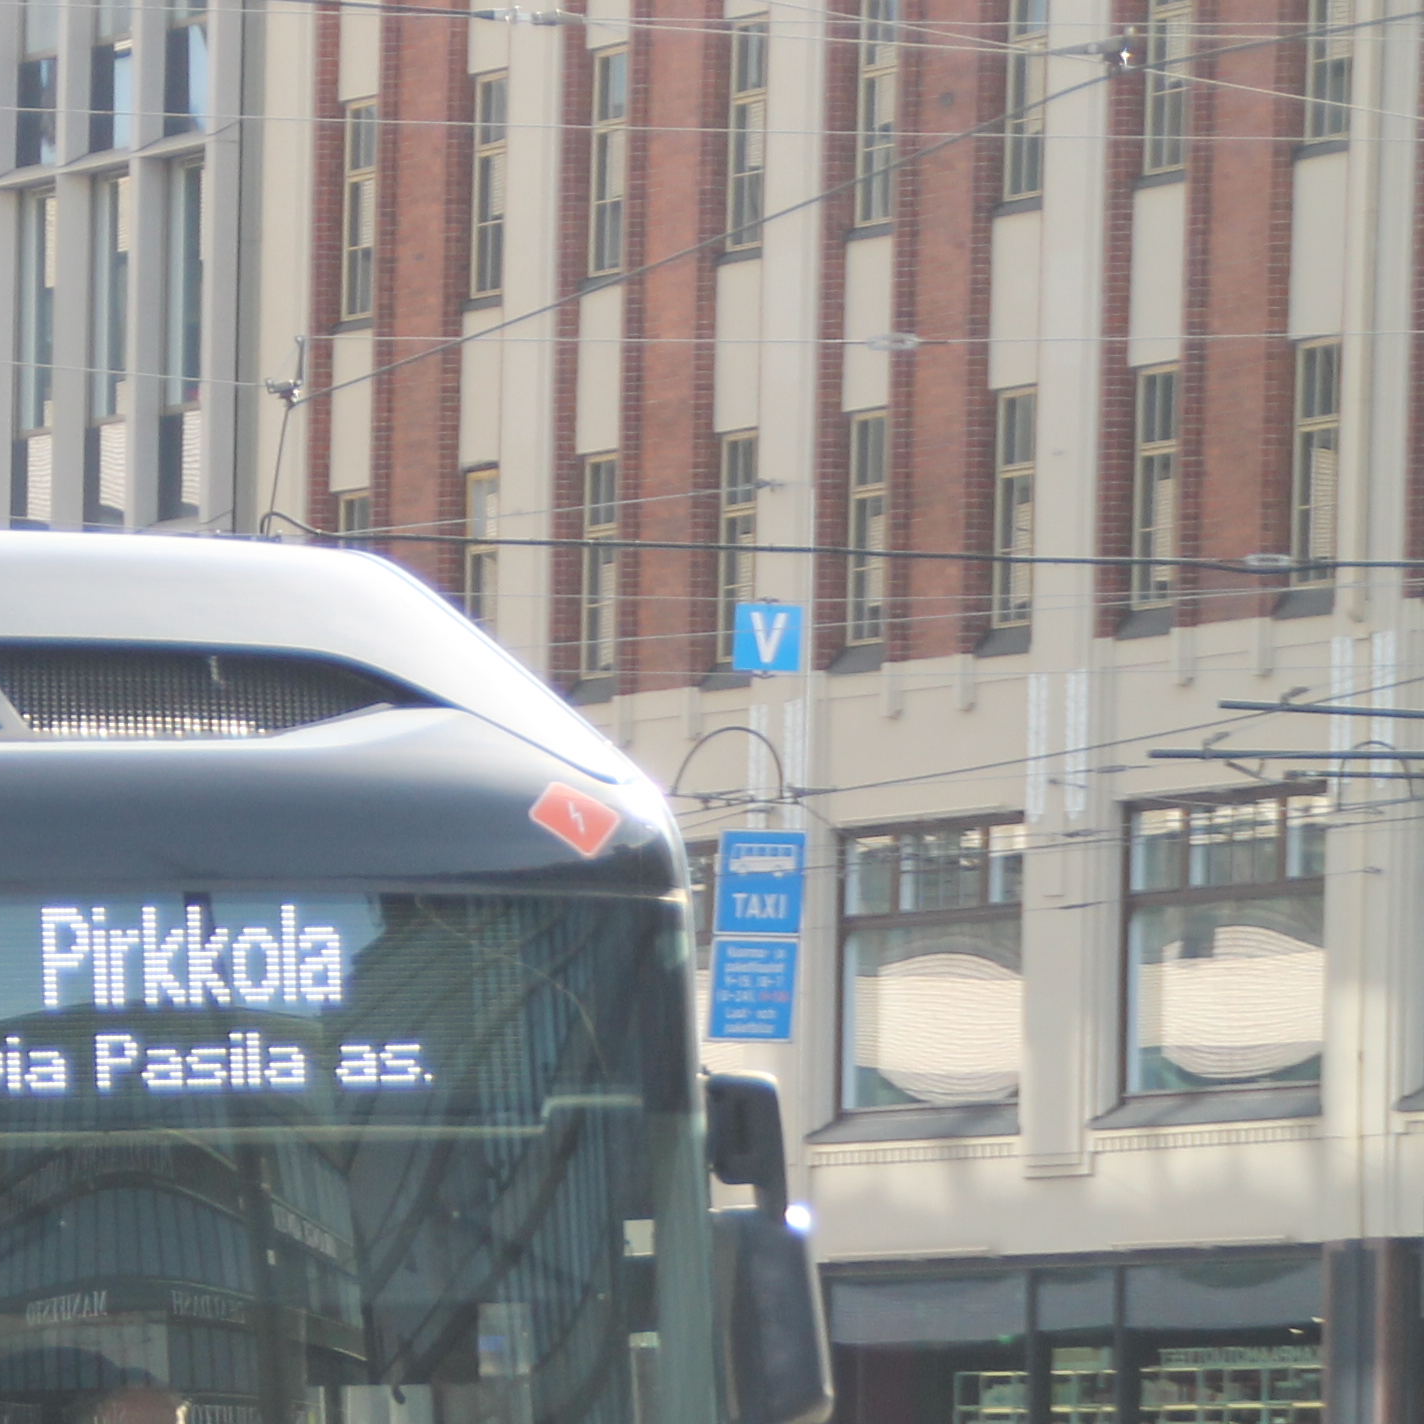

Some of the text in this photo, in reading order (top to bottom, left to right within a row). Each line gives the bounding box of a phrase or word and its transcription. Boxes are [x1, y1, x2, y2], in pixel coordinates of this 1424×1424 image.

[730, 892, 788, 920] TAXI
[39, 903, 345, 1010] Pirkkola
[93, 1030, 308, 1094] Pasila
[334, 1040, 436, 1086] as.
